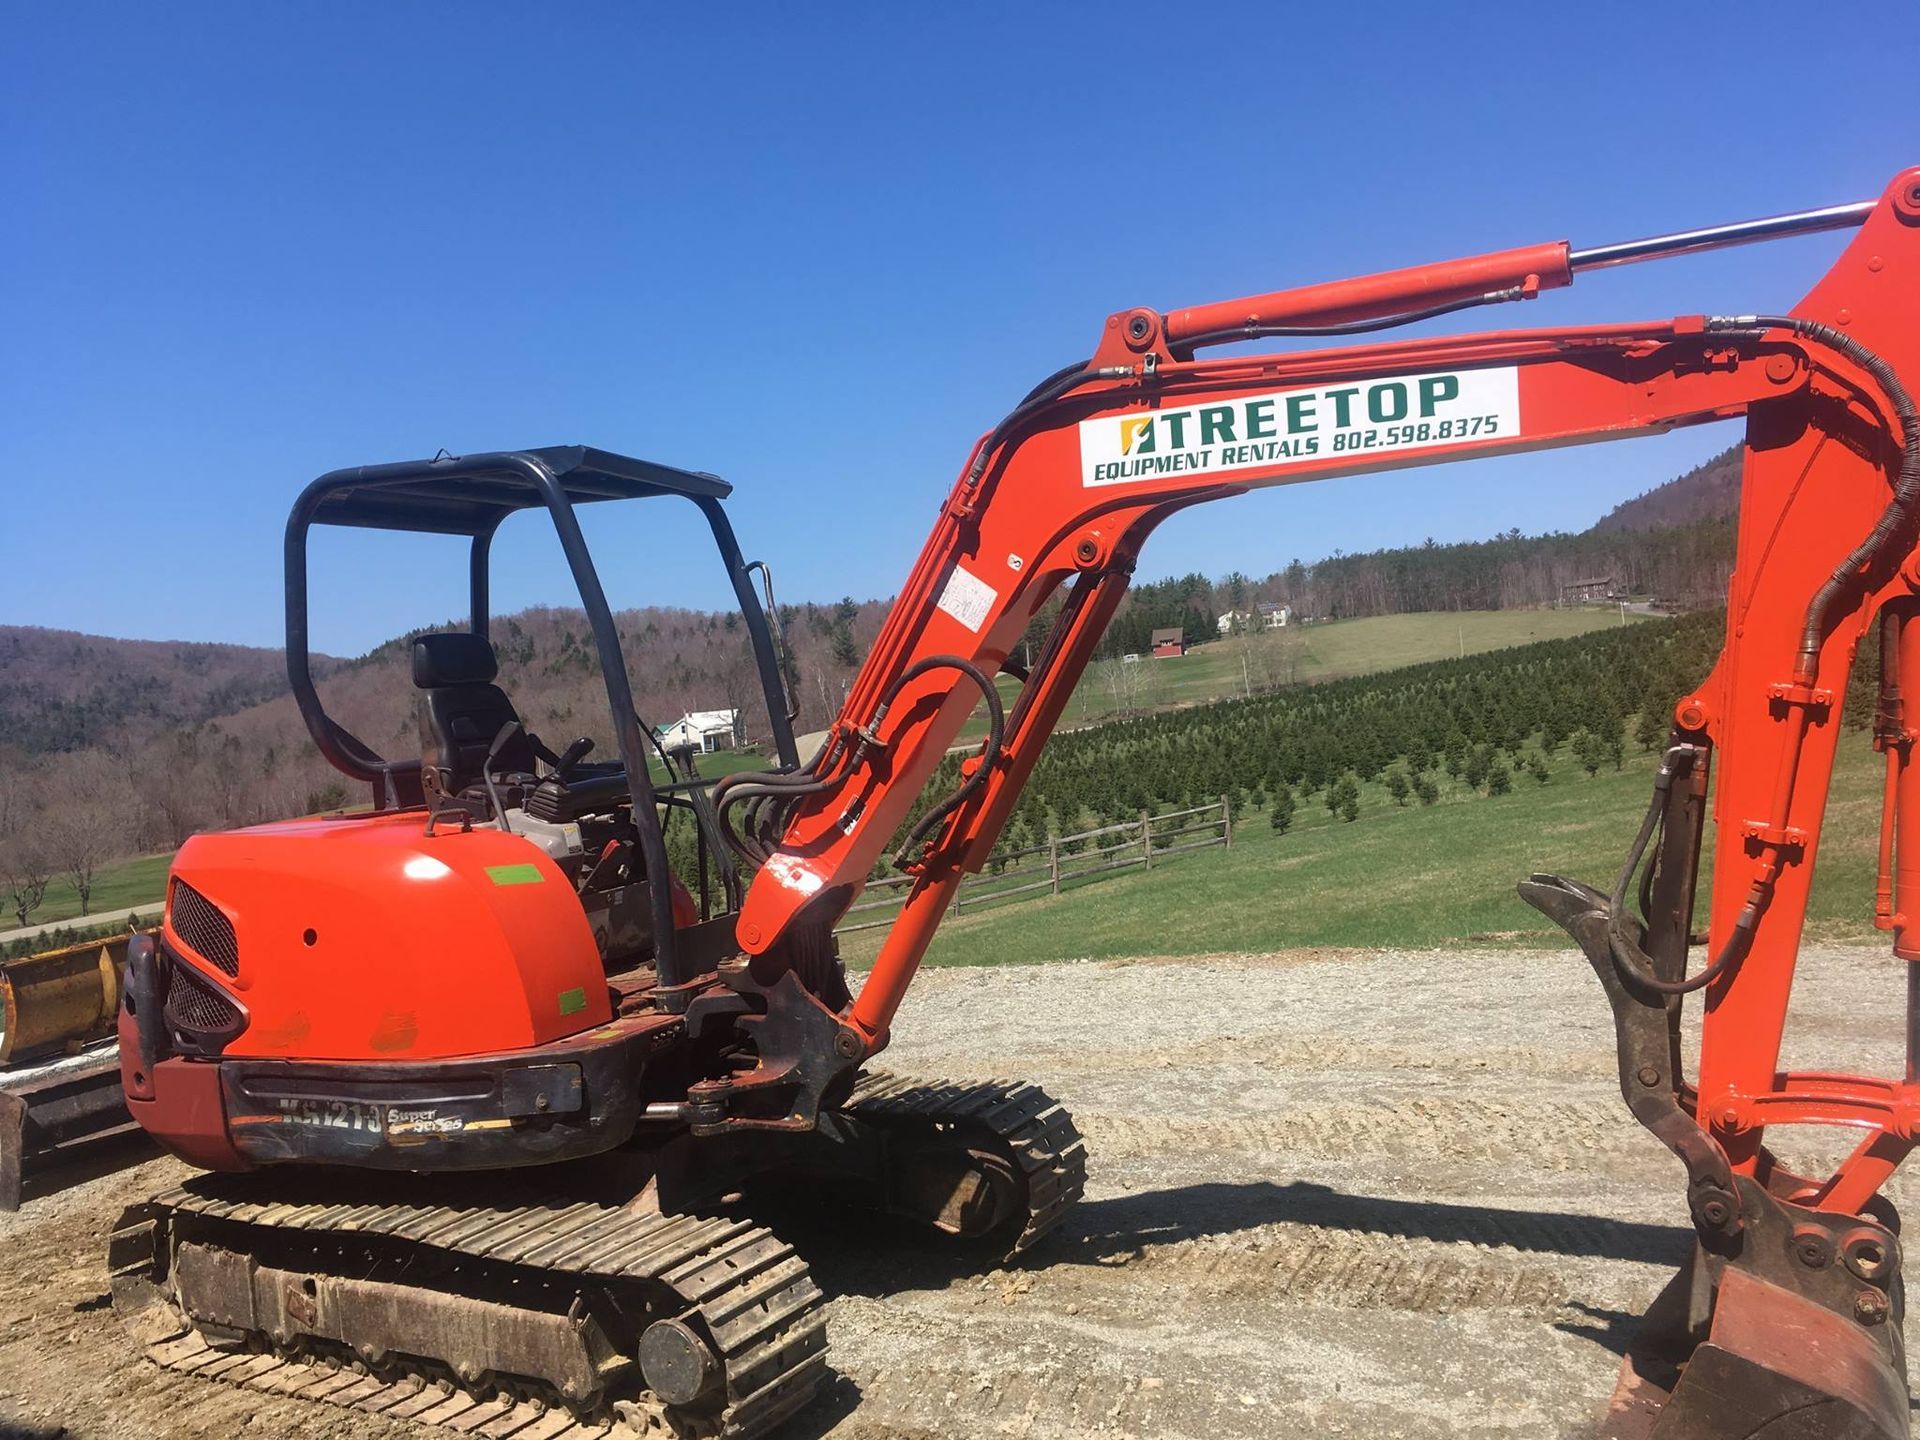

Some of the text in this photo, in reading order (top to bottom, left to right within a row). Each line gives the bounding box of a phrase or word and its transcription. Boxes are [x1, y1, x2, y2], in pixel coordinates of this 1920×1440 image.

[1161, 375, 1459, 450] TREETOP
[1094, 415, 1499, 480] EQUIPMENT RENTALS 802.598.8375
[388, 1109, 437, 1122] Super
